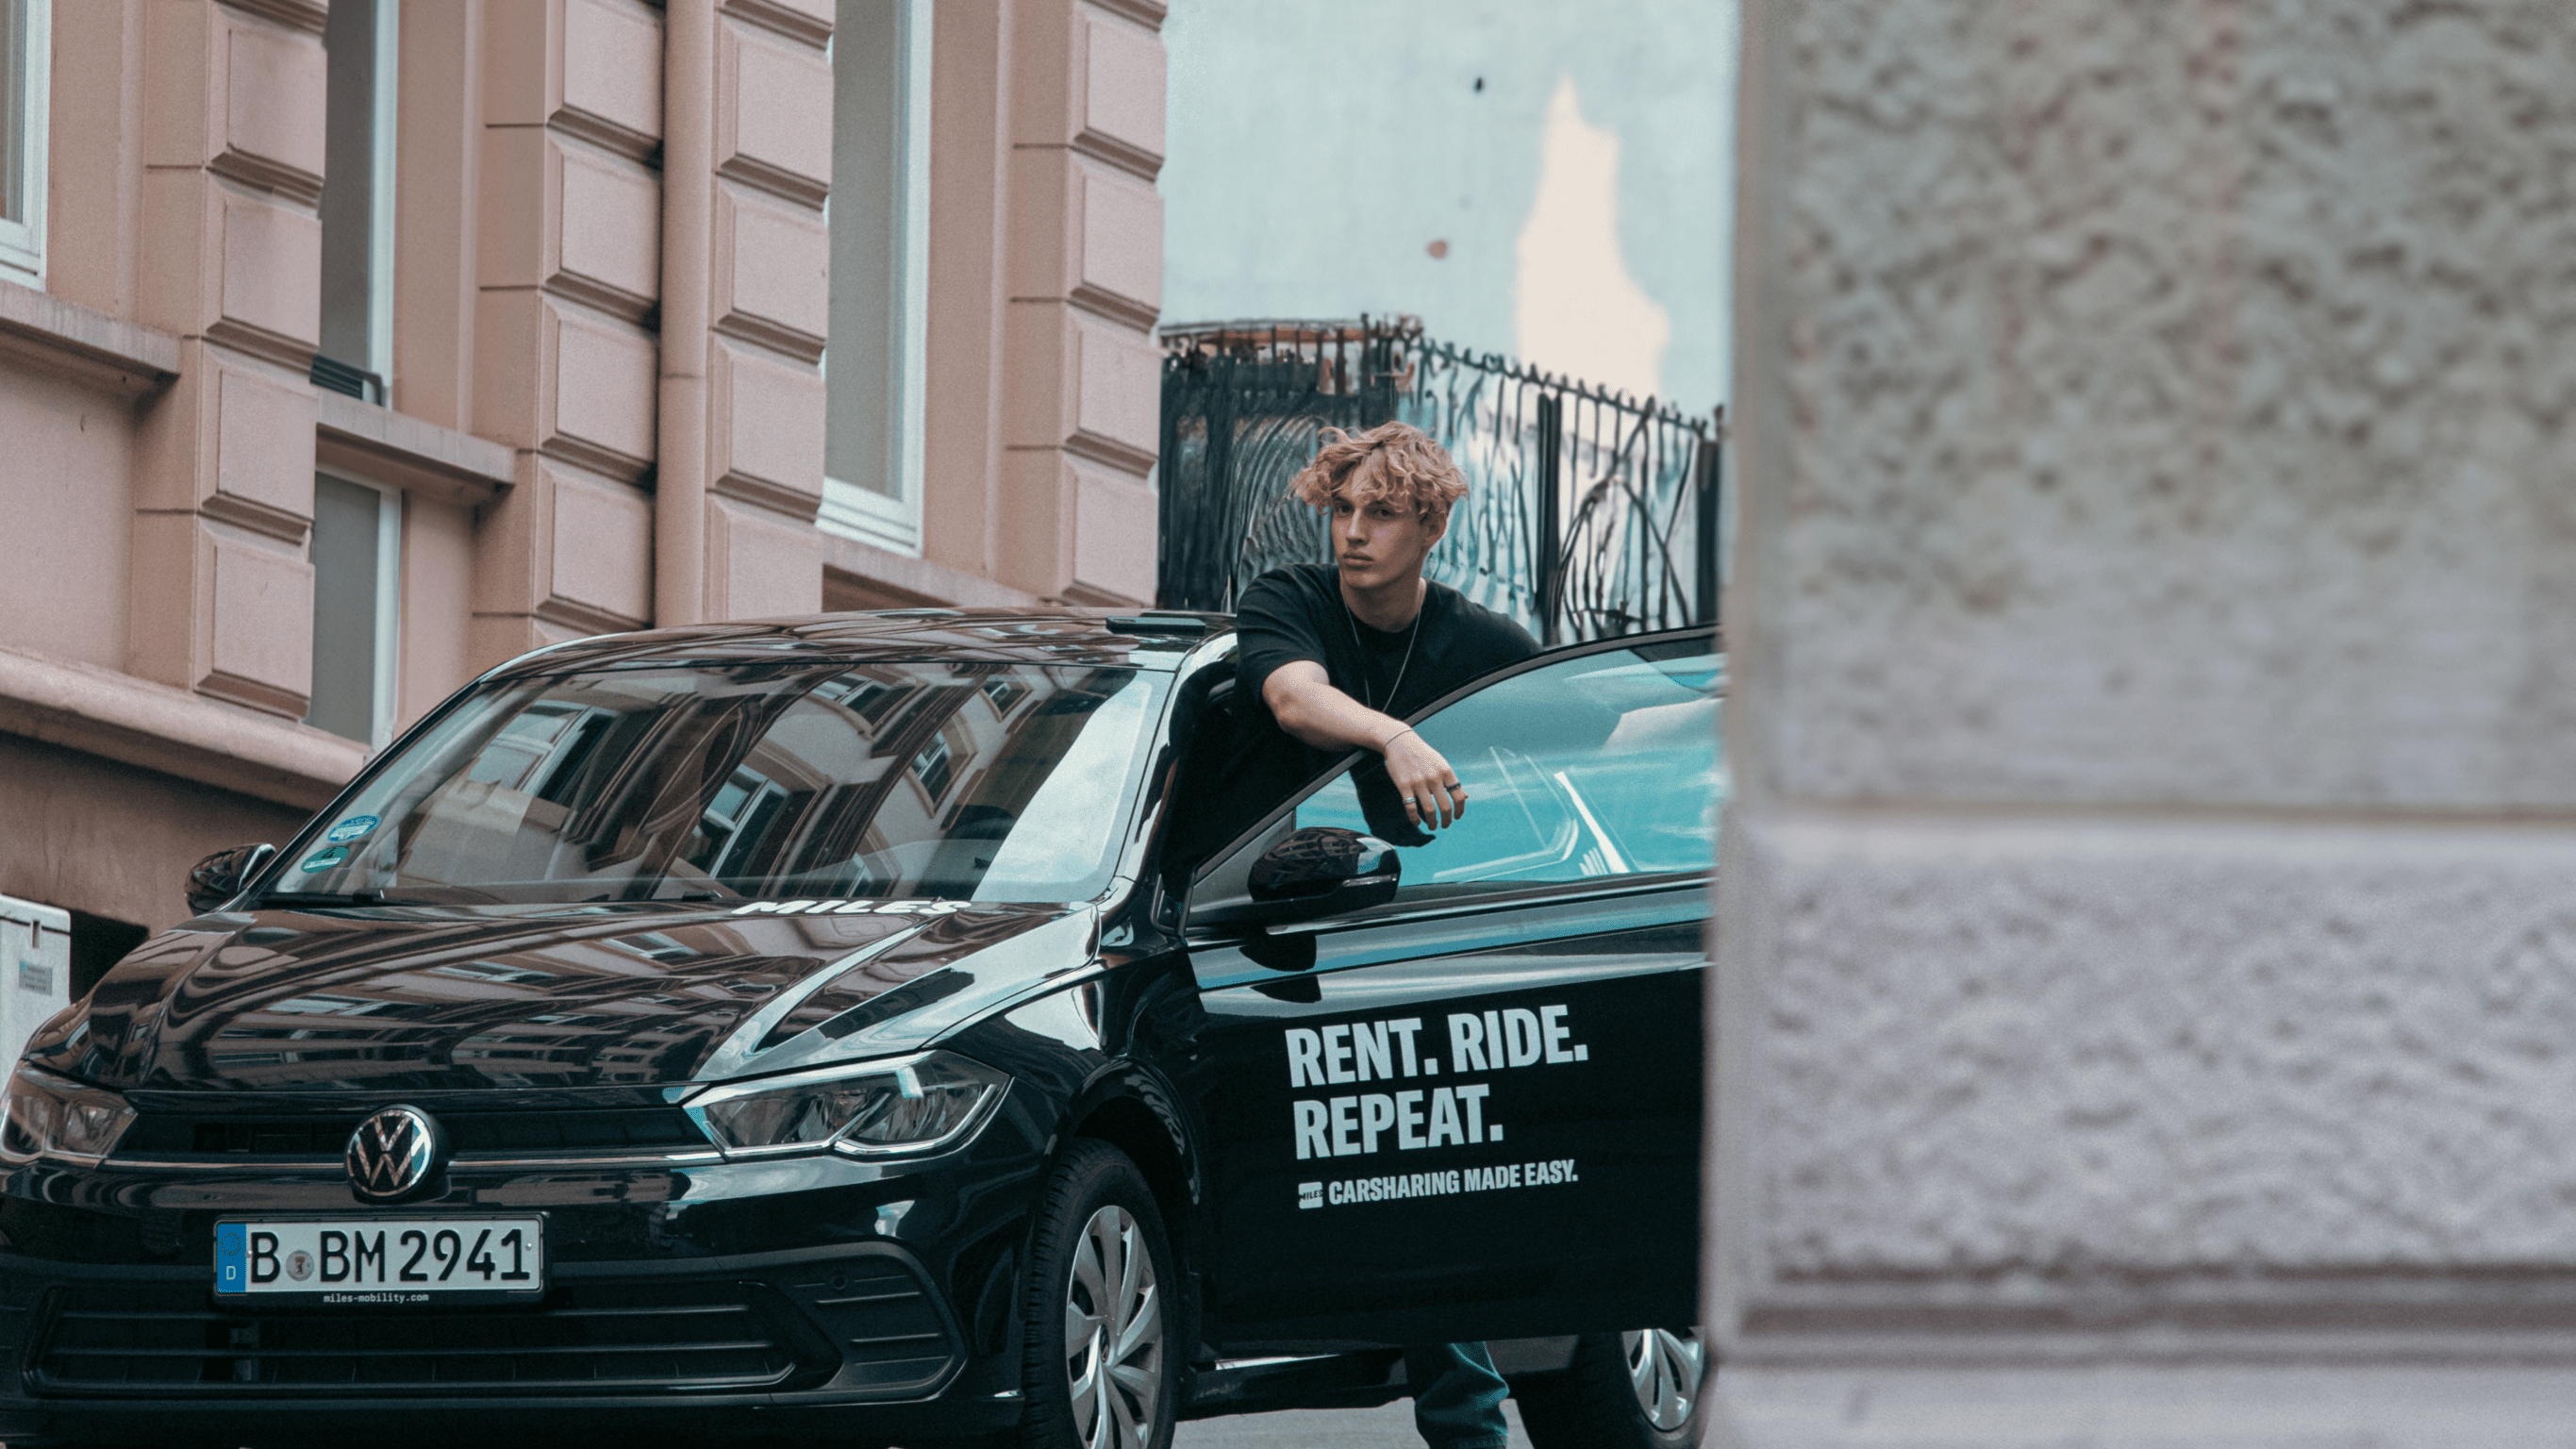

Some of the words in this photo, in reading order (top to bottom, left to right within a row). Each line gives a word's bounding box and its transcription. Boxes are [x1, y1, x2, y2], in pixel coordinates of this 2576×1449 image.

[731, 900, 972, 915] MILES
[1285, 1017, 1438, 1088] RENT.
[1448, 1004, 1589, 1074] RIDE.
[1293, 1084, 1504, 1160] REPEAT.
[1328, 1172, 1460, 1205] CARSHARING
[1464, 1164, 1521, 1192] MADE
[1524, 1158, 1579, 1186] EASY.
[226, 1265, 236, 1280] D
[250, 1231, 280, 1283] B
[320, 1230, 386, 1282] BM
[399, 1228, 530, 1282] 2941
[323, 1293, 429, 1304] miles-mobility.com
